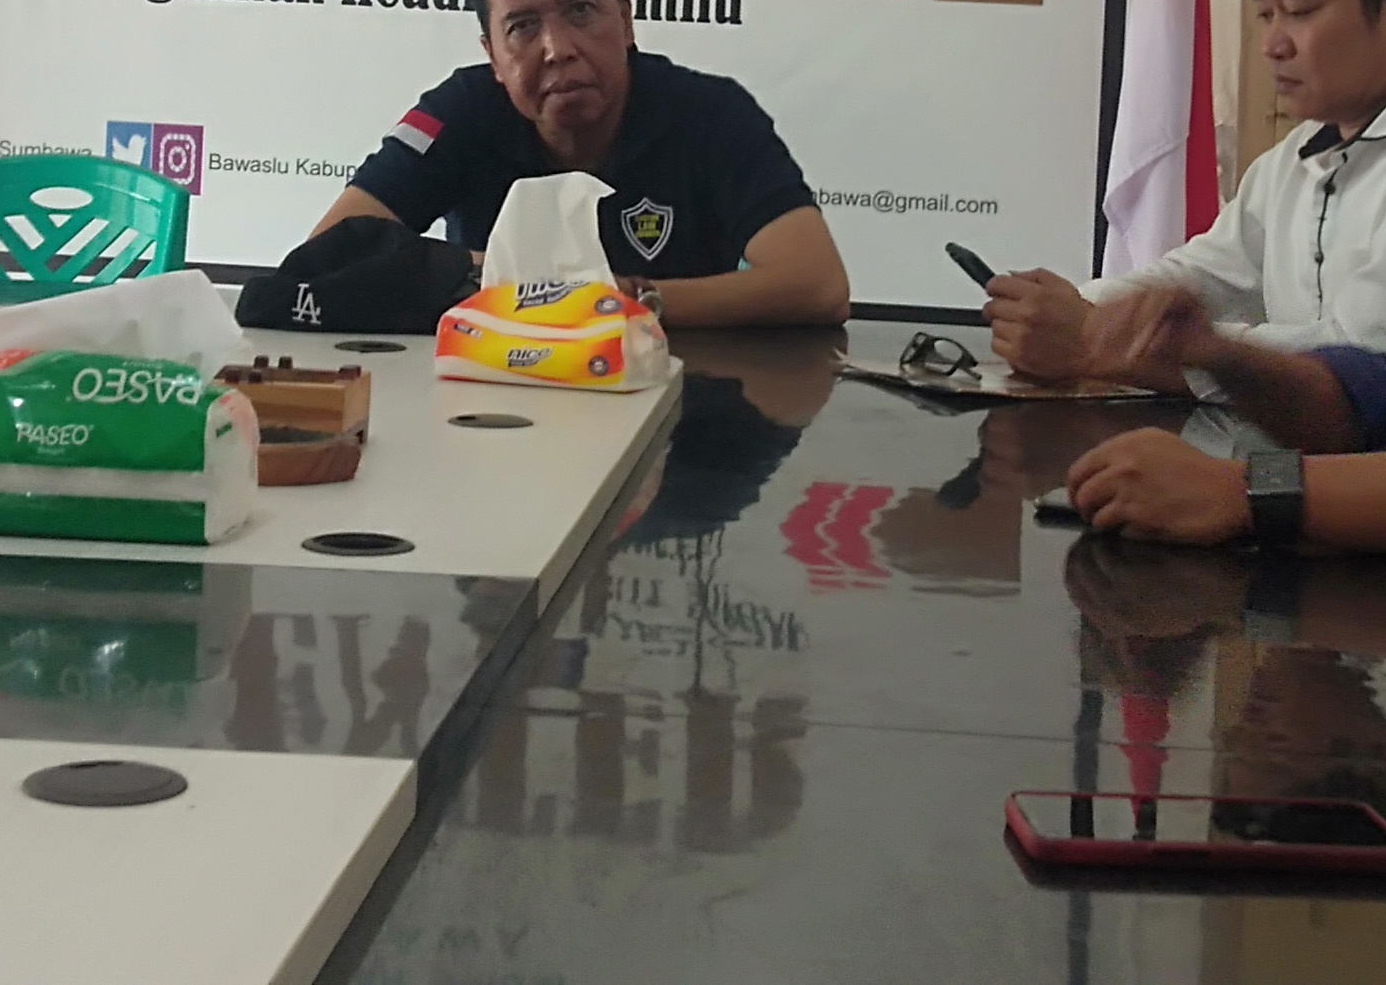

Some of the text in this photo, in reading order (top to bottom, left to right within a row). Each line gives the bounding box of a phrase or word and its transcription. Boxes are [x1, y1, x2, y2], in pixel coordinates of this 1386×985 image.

[208, 153, 360, 182] Bawaslu Kabup
[292, 283, 321, 325] LA
[15, 422, 90, 446] PASEO
